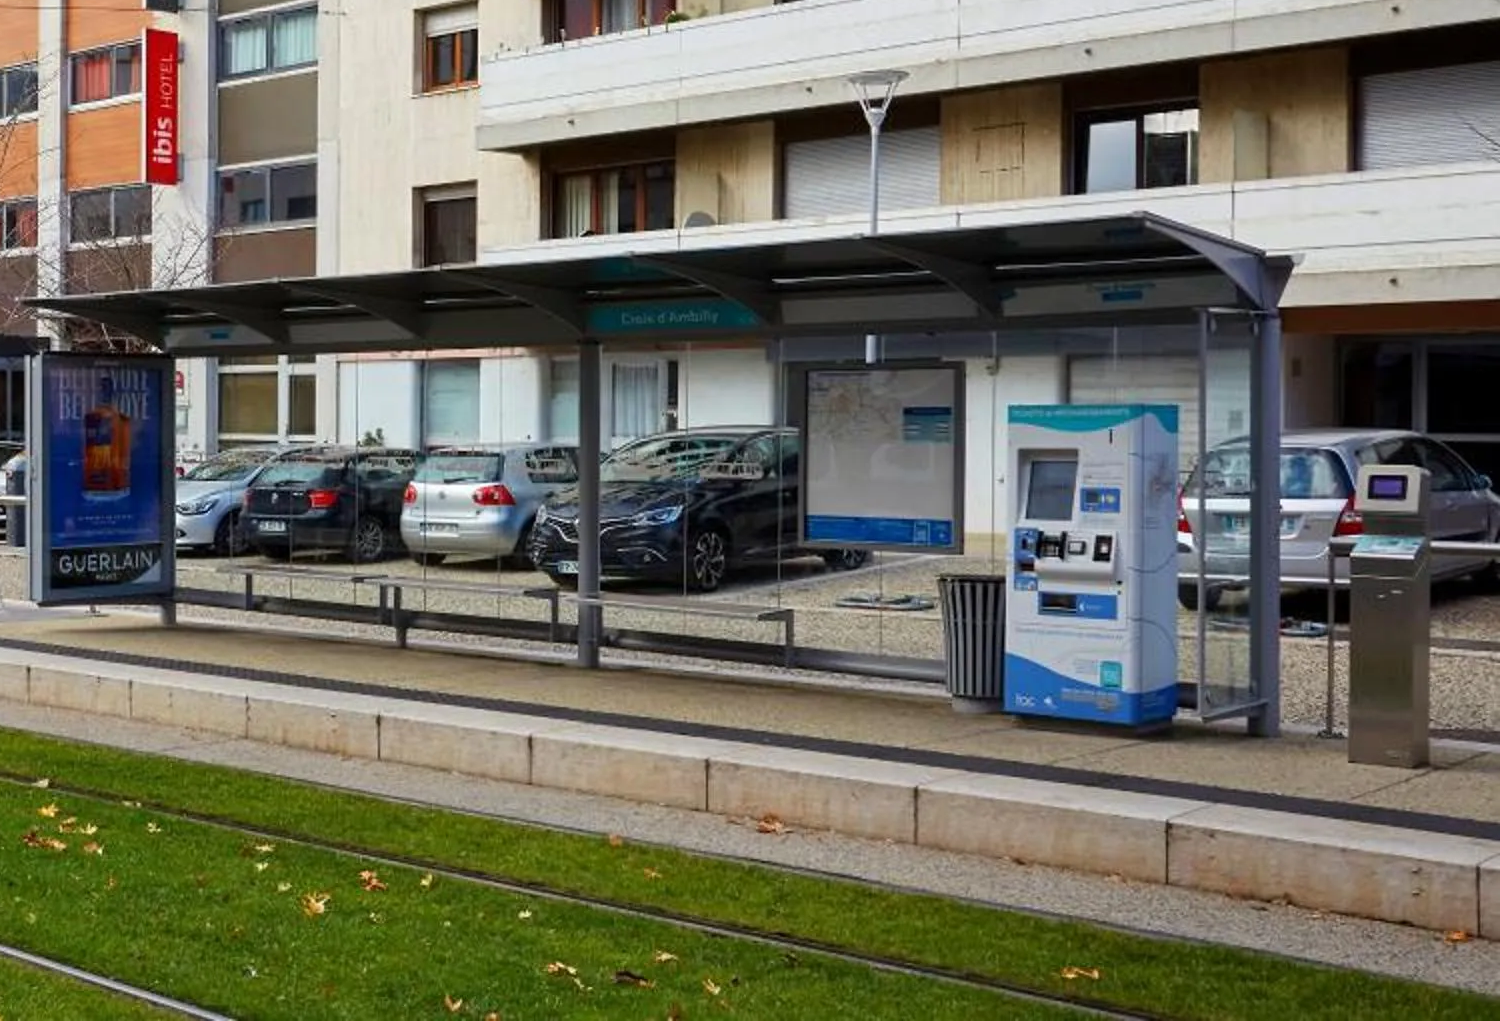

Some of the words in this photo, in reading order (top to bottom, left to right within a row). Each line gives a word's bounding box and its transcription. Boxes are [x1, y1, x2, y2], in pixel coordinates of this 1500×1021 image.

[160, 54, 173, 109] HOTEL
[153, 116, 173, 164] ibis
[59, 550, 154, 574] GUERLAIN
